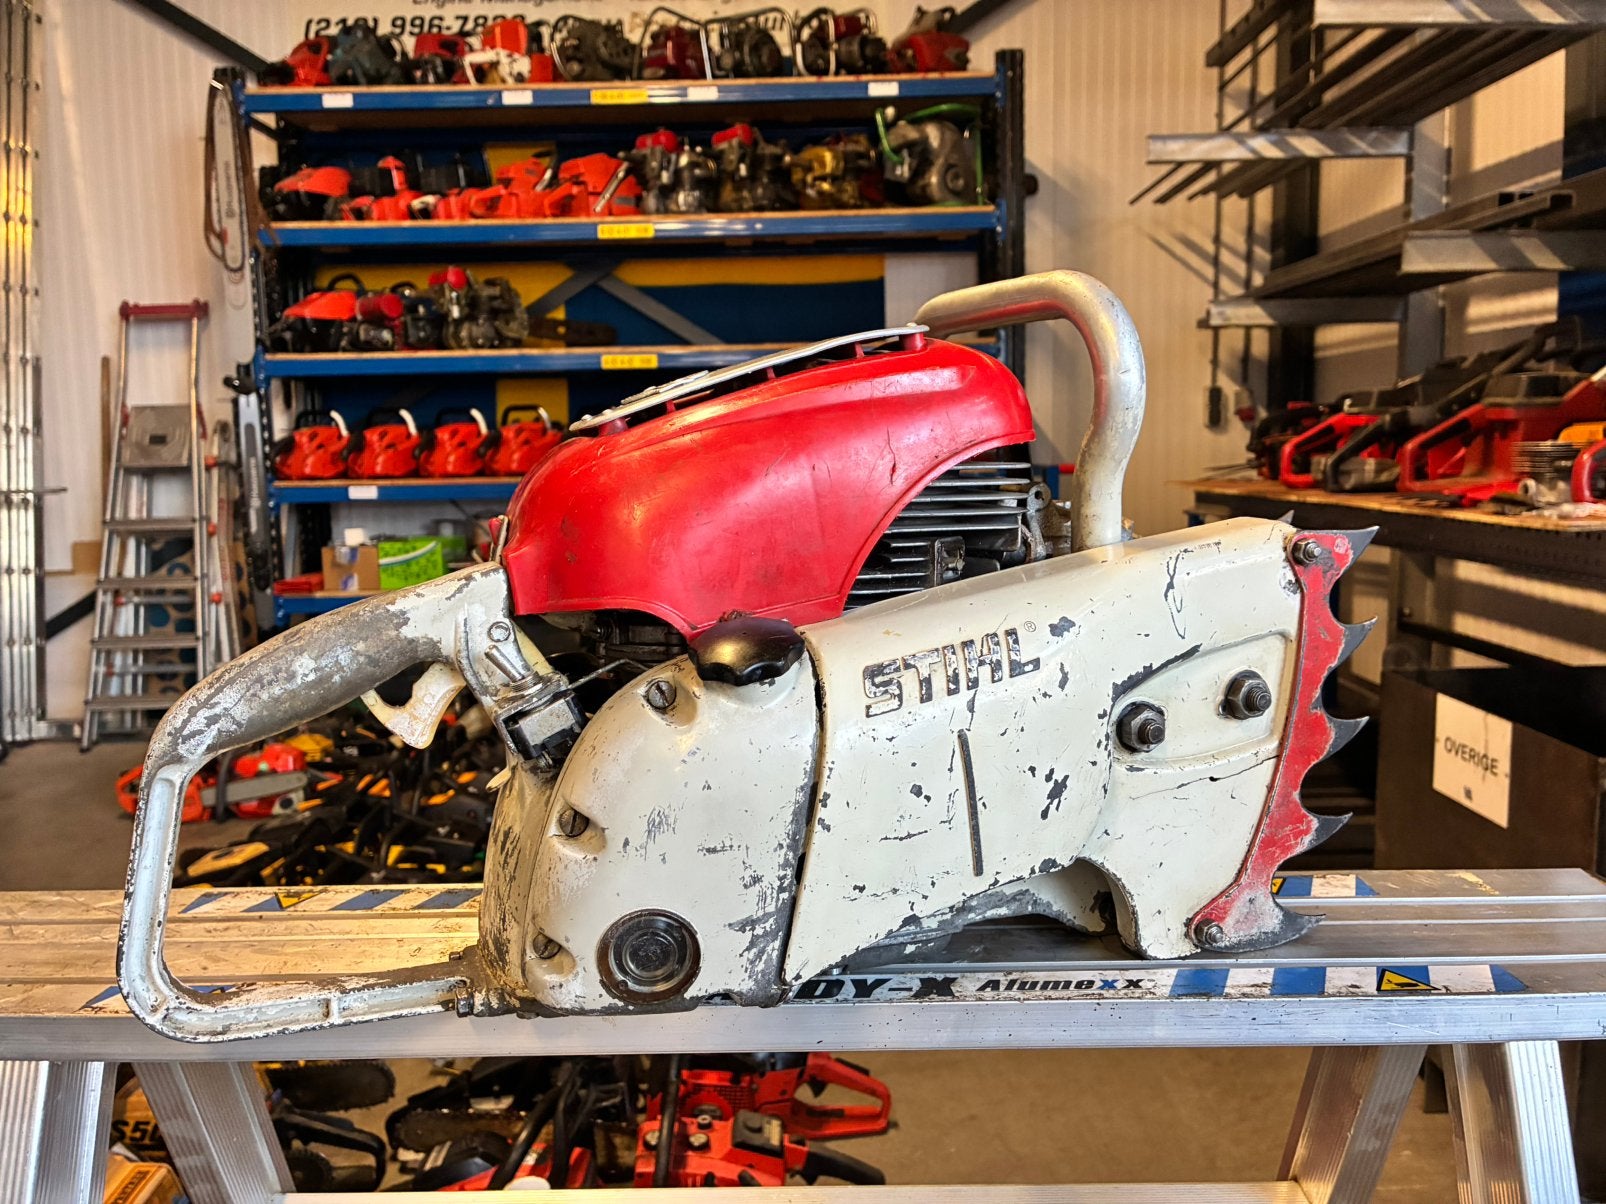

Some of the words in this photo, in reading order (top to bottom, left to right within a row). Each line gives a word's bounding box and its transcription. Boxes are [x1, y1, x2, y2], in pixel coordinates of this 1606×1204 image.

[391, 15, 526, 36] 996-78
[863, 627, 1041, 719] STIHL
[1444, 736, 1499, 777] OVERIGE
[975, 978, 1145, 992] Alumexx
